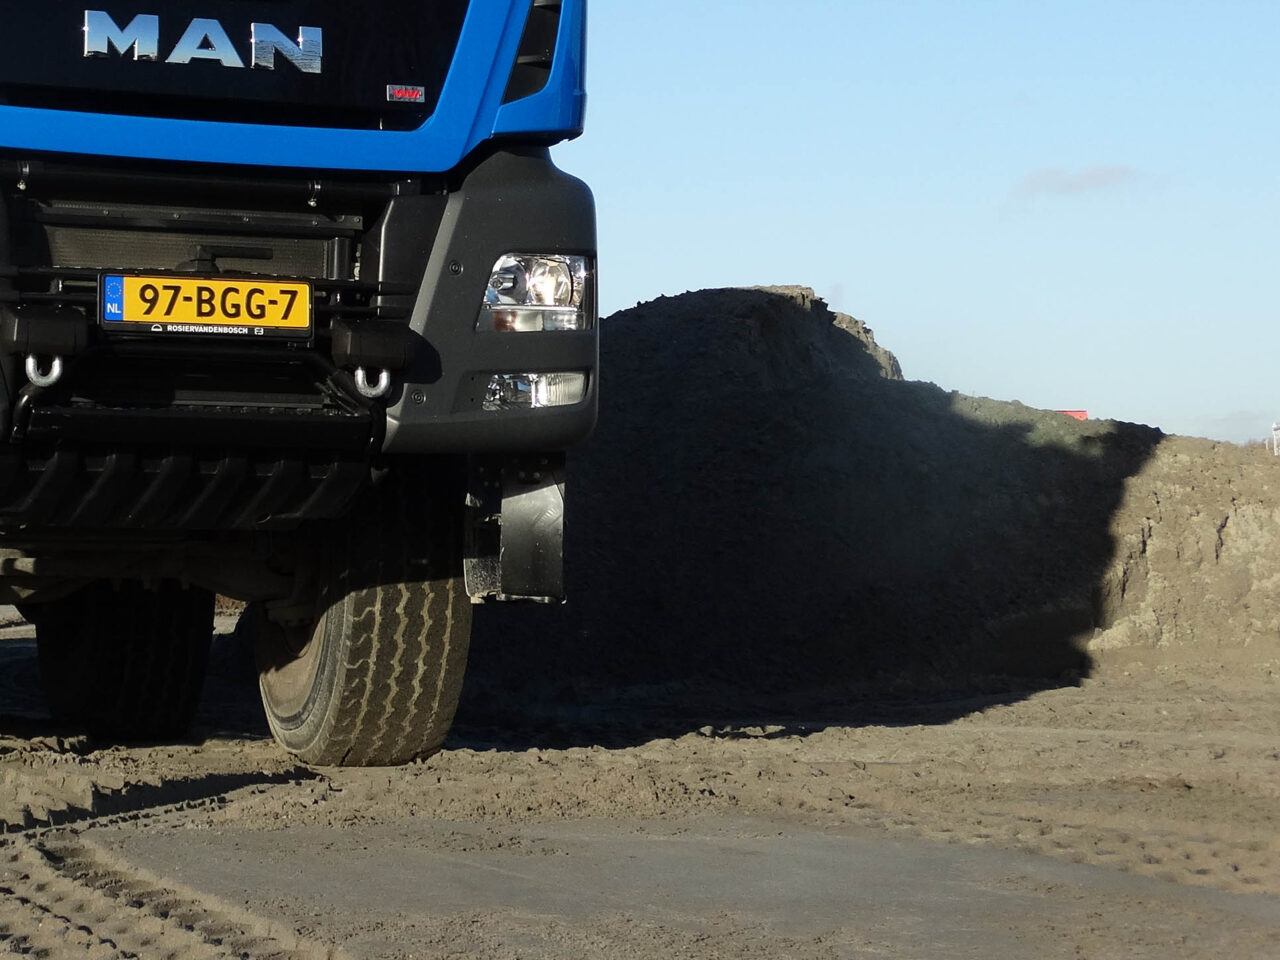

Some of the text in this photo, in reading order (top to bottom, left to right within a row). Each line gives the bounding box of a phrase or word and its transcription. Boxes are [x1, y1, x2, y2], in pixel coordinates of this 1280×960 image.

[83, 10, 323, 74] MAN
[106, 303, 122, 315] NL
[138, 283, 299, 321] 97-BGG-7
[167, 324, 249, 334] ROSIERVANDENBOSCH
